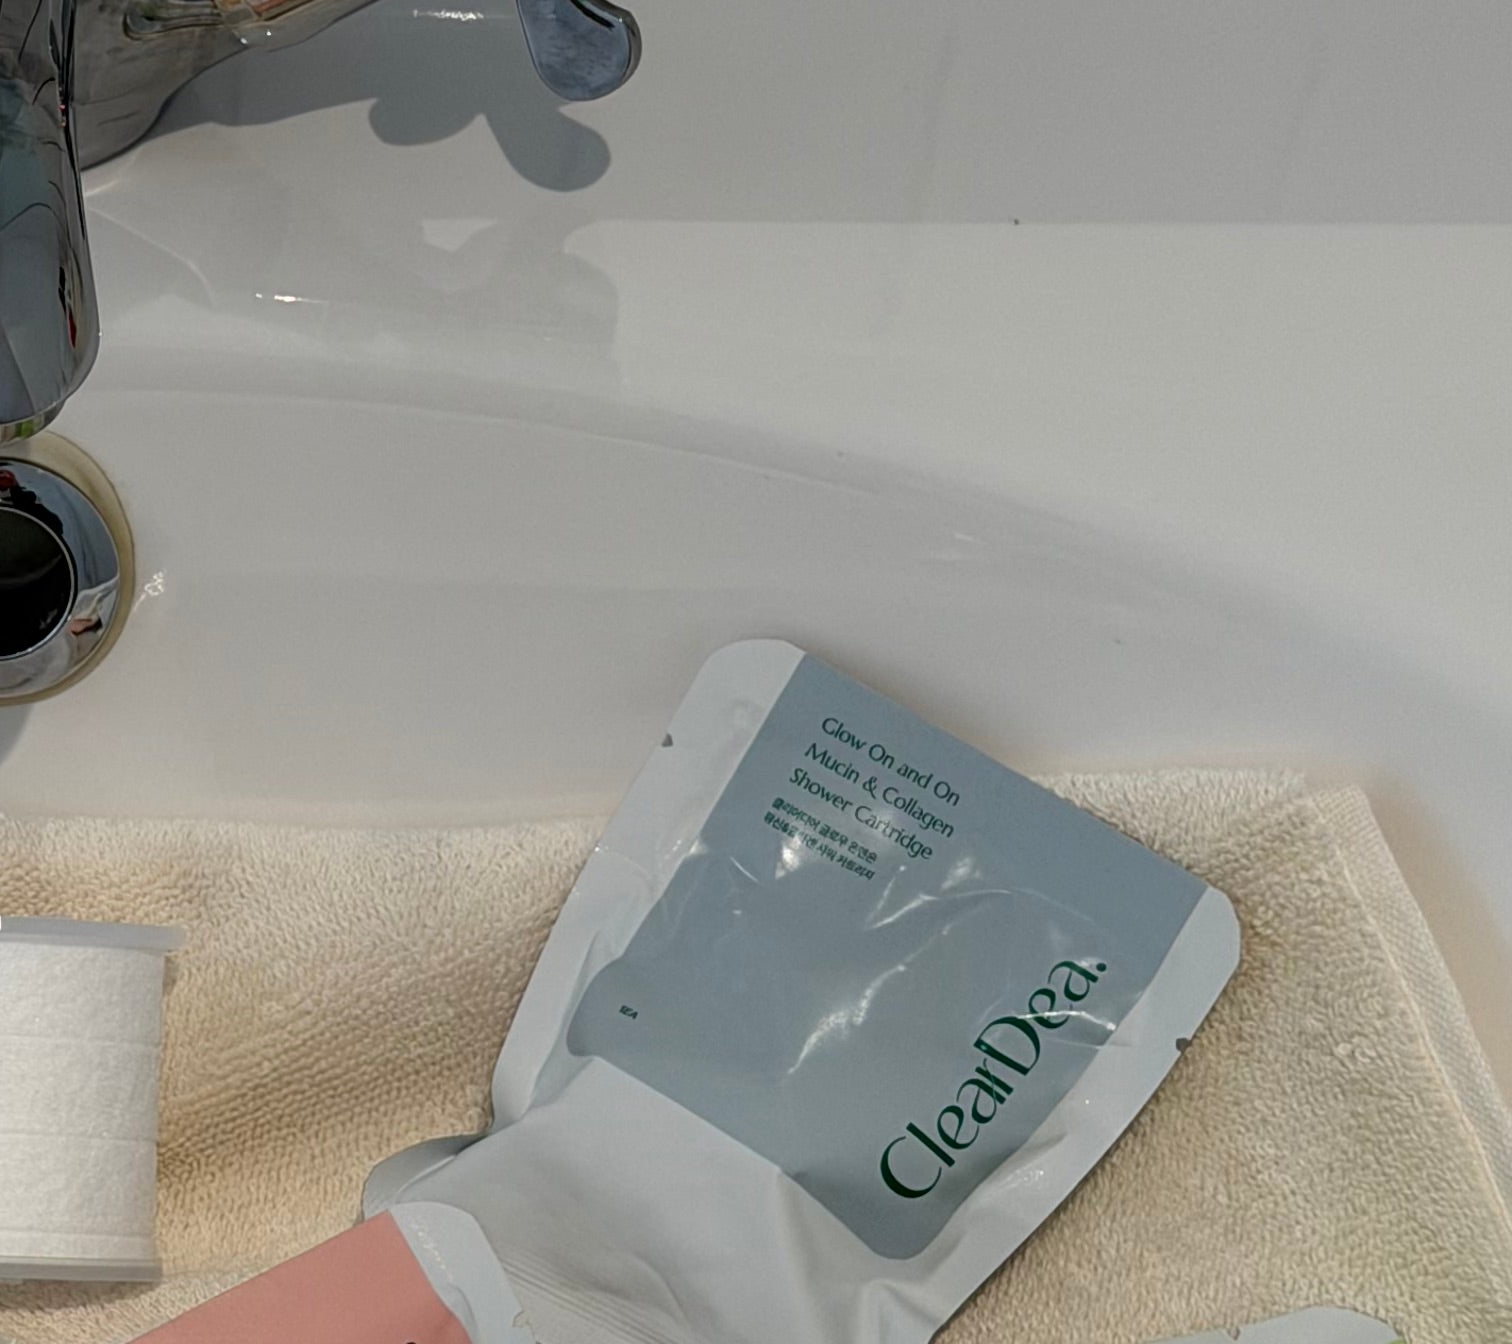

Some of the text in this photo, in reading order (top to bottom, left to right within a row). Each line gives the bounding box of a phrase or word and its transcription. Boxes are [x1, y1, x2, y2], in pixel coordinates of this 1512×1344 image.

[803, 742, 955, 839] Mucin & Collagen
[821, 716, 961, 807] Glow On and On
[789, 767, 933, 860] Shower Cartridge
[878, 959, 1108, 1200] ClearDea.
